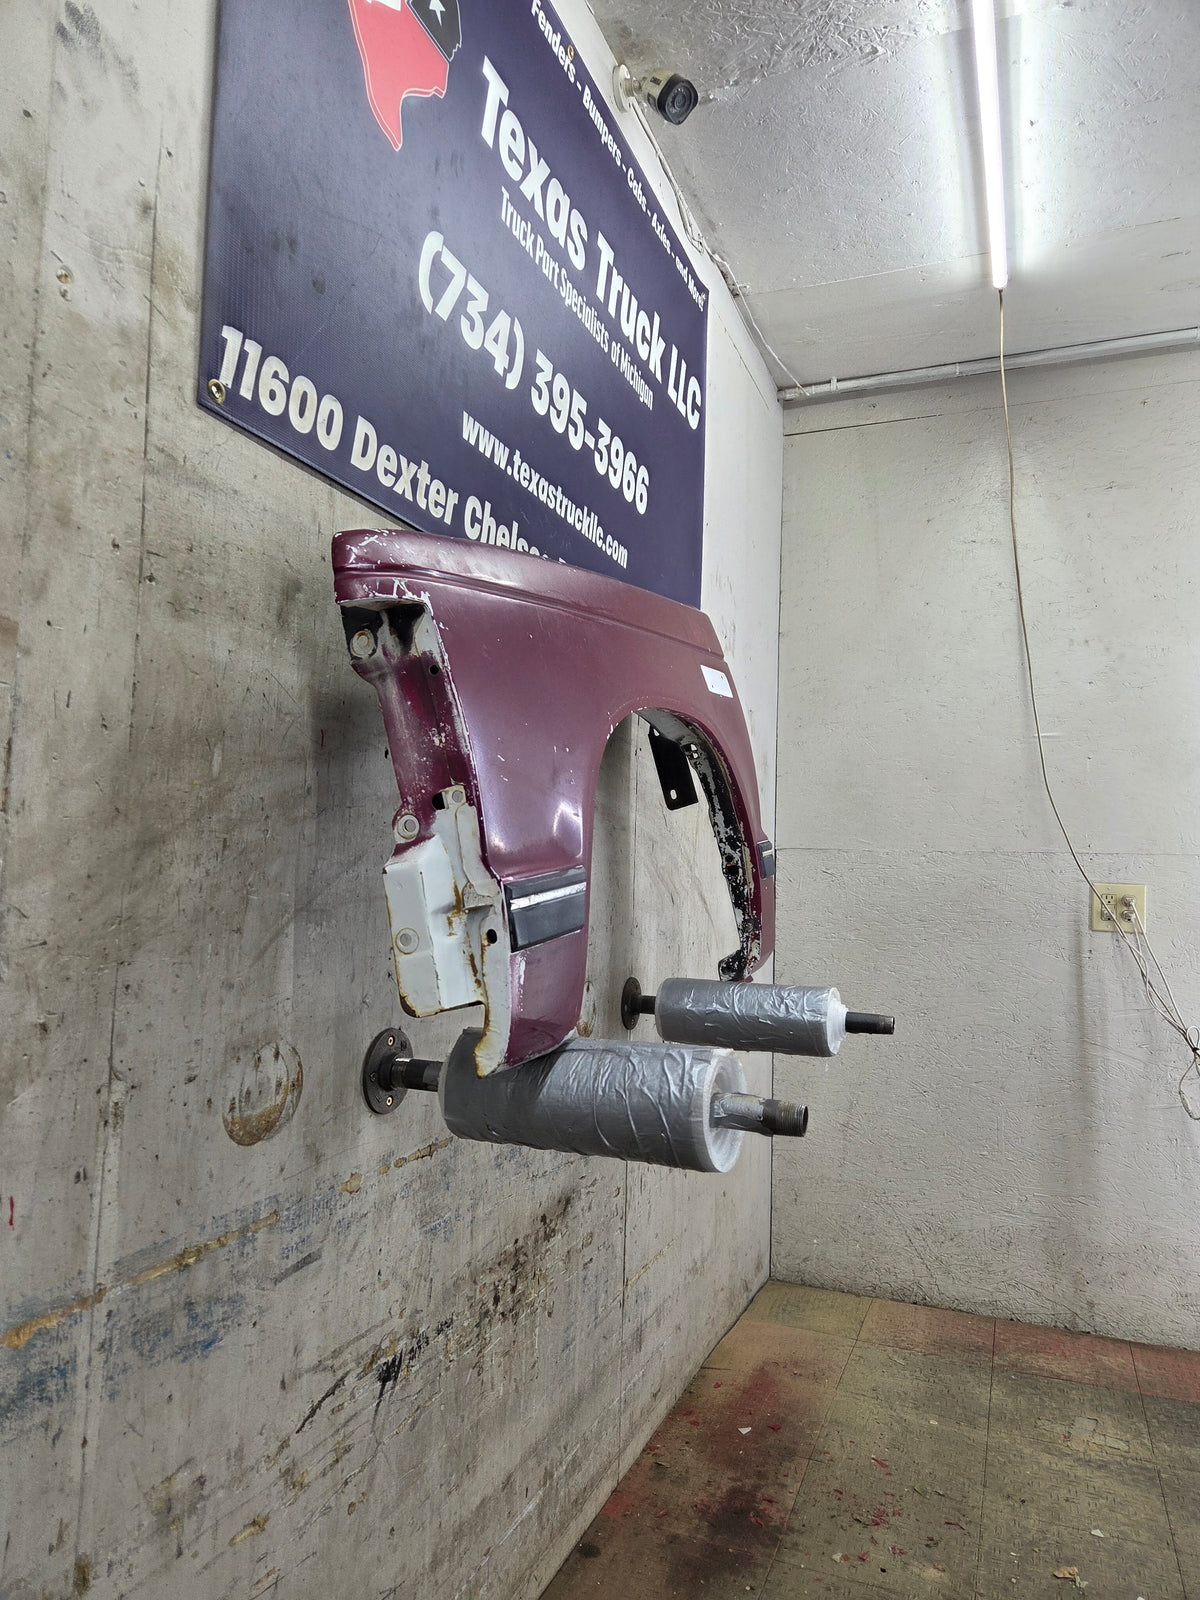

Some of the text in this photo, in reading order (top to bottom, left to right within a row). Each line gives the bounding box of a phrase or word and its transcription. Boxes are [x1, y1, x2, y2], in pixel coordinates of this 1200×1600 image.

[481, 55, 702, 430] Texas Truck LLC
[531, 0, 576, 83] Fenders
[582, 84, 622, 166] Bumpers
[627, 167, 647, 212] Cabs
[651, 212, 671, 255] Axles
[675, 255, 688, 284] and
[218, 325, 344, 451] 11600
[350, 415, 459, 525] Dexter
[418, 230, 650, 515] (734) 395-3966
[501, 185, 653, 411] Truck Part Specialists of Michigan
[462, 410, 629, 569] www.texastruckllc.com
